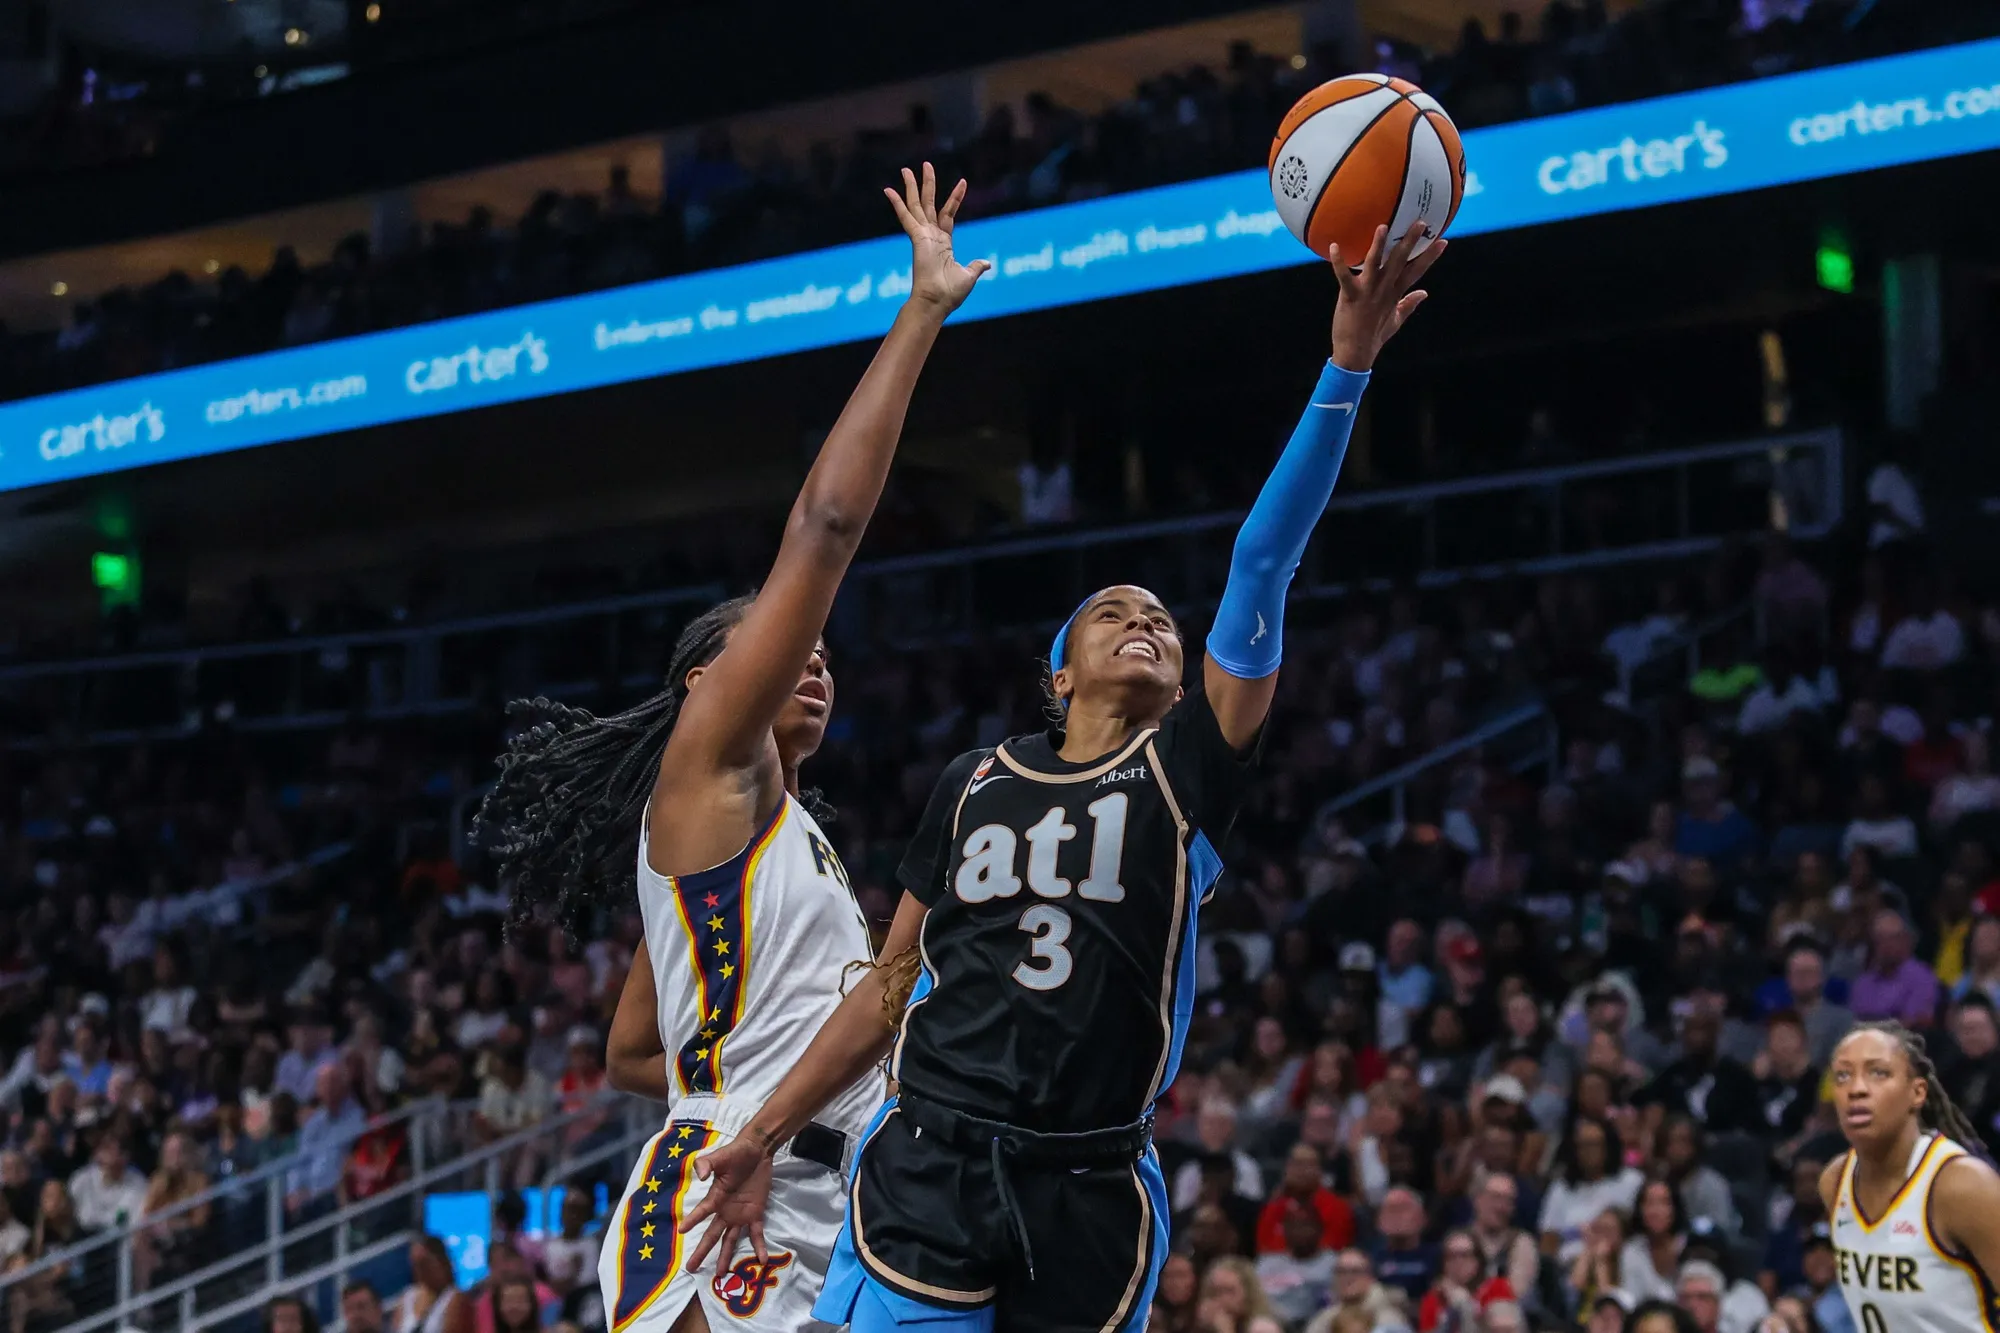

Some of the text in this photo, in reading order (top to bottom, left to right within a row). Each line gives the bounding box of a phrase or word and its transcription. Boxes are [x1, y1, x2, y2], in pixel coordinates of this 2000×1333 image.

[1537, 120, 1729, 195] carter's
[699, 306, 739, 331] the
[405, 331, 550, 393] carter's
[205, 374, 368, 423] carters.com
[38, 401, 166, 461] carter's
[1095, 765, 1147, 788] Albert
[955, 792, 1128, 903] atl
[1012, 904, 1073, 990] 3
